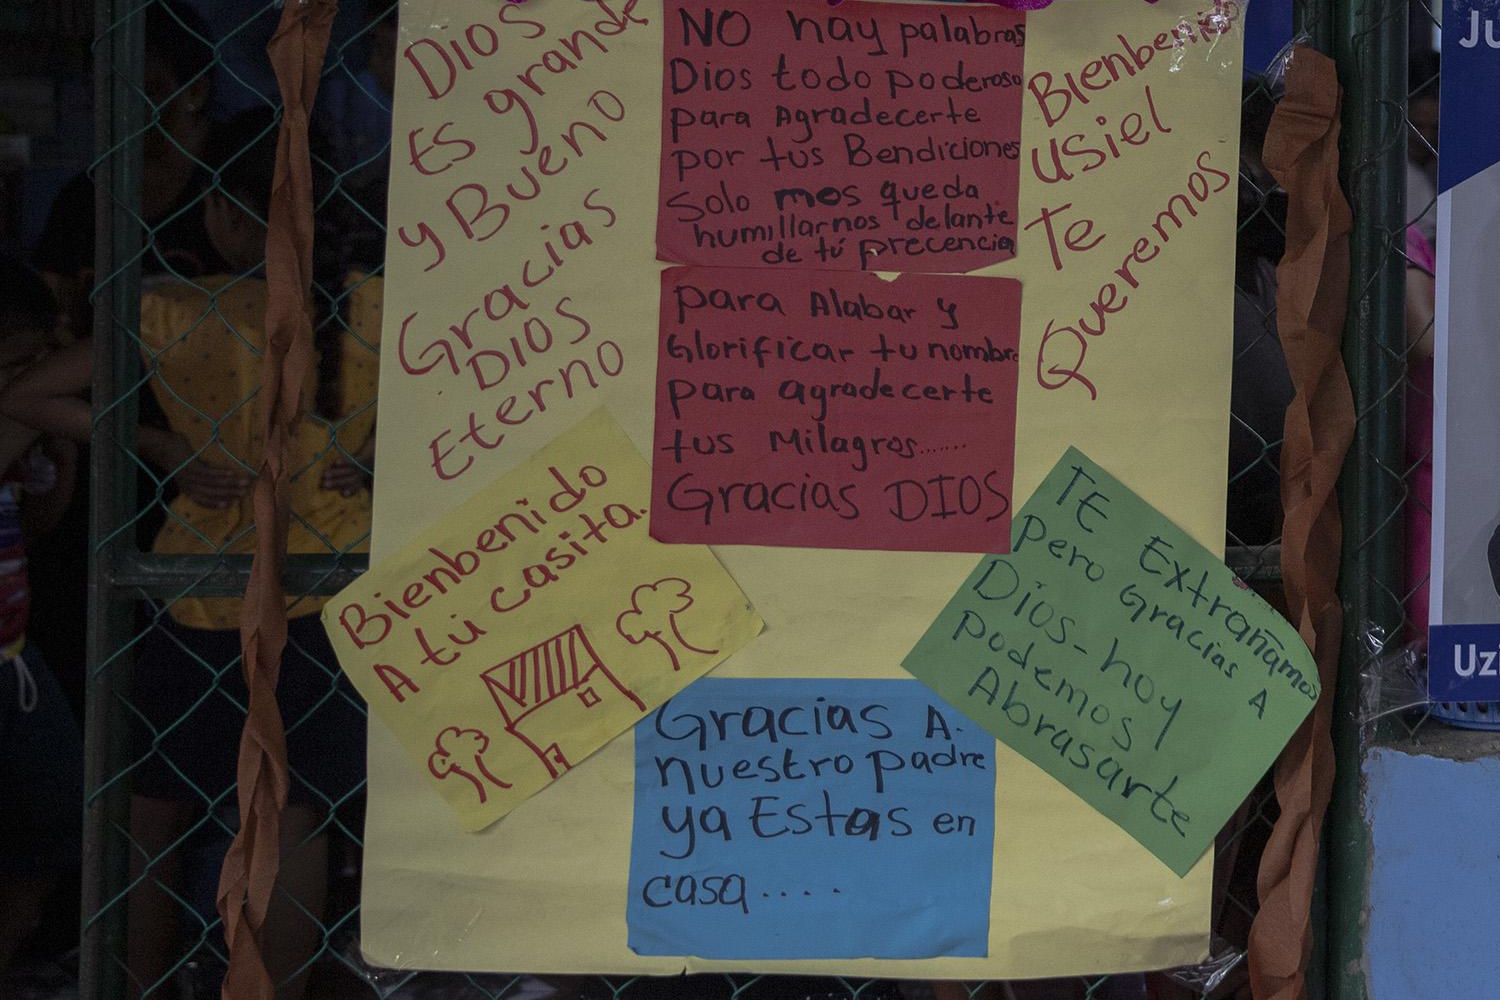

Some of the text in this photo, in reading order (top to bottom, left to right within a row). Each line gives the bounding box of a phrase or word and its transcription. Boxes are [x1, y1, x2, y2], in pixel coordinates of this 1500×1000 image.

[679, 7, 1026, 57] NO hay palabras
[670, 57, 751, 94] Dios
[776, 97, 981, 144] Agradecerte
[398, 89, 625, 272] y Bueno
[672, 133, 1020, 181] por tus Bendiciones
[666, 180, 750, 222] Solo
[880, 174, 979, 221] queda
[693, 203, 1014, 249] humillarnos delante
[1024, 203, 1106, 271] Te
[761, 241, 802, 265] de
[859, 235, 1015, 271] precencia
[1037, 151, 1230, 400] Queremos
[399, 187, 616, 376] Gracias
[810, 287, 917, 323] Alabar
[666, 330, 854, 369] Glorificar
[870, 334, 918, 362] tu
[429, 340, 624, 481] Eterno
[778, 367, 994, 422] agradecerte
[661, 428, 735, 464] tus
[667, 469, 1010, 526] Gracias DIOS
[339, 465, 608, 649] Bienbenido
[1119, 584, 1239, 679] Gracias
[1248, 688, 1267, 719] A
[373, 664, 419, 701] A
[655, 696, 893, 751] Gracias
[655, 748, 853, 795] nuestro
[967, 666, 1191, 839] Abrasarte
[660, 790, 976, 859] ya Estas en
